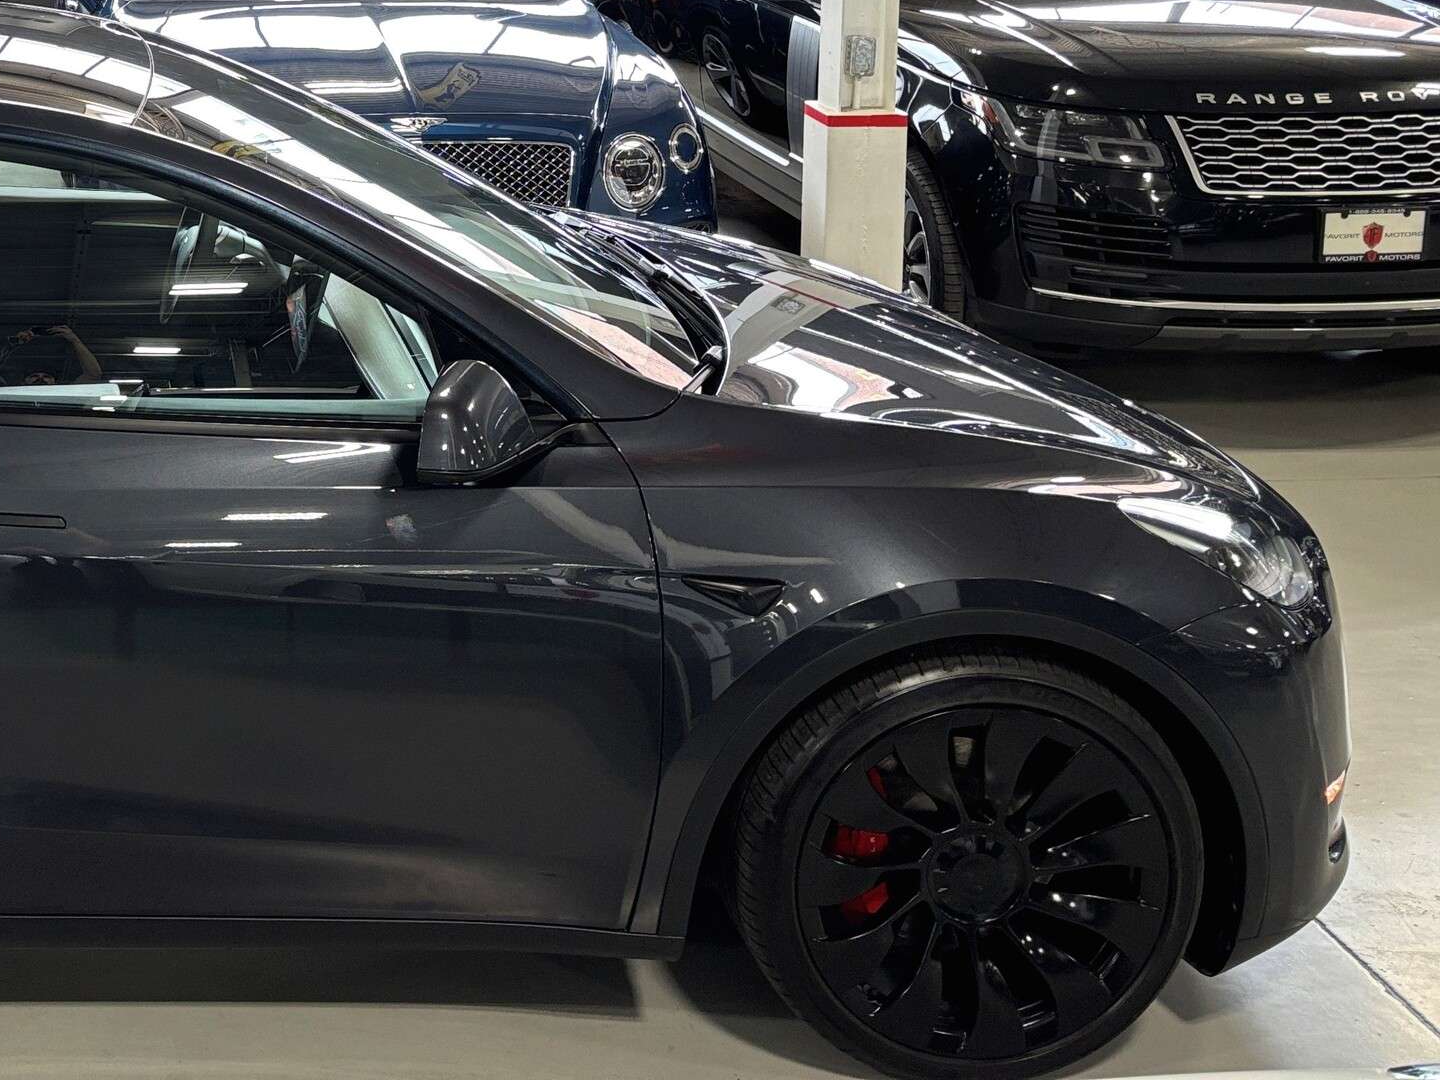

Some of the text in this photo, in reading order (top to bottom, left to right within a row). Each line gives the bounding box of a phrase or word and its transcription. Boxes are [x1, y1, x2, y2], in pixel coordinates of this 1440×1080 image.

[1196, 93, 1332, 105] RANGE
[1326, 232, 1360, 240] AVORIT
[1379, 253, 1421, 261] MOTORS
